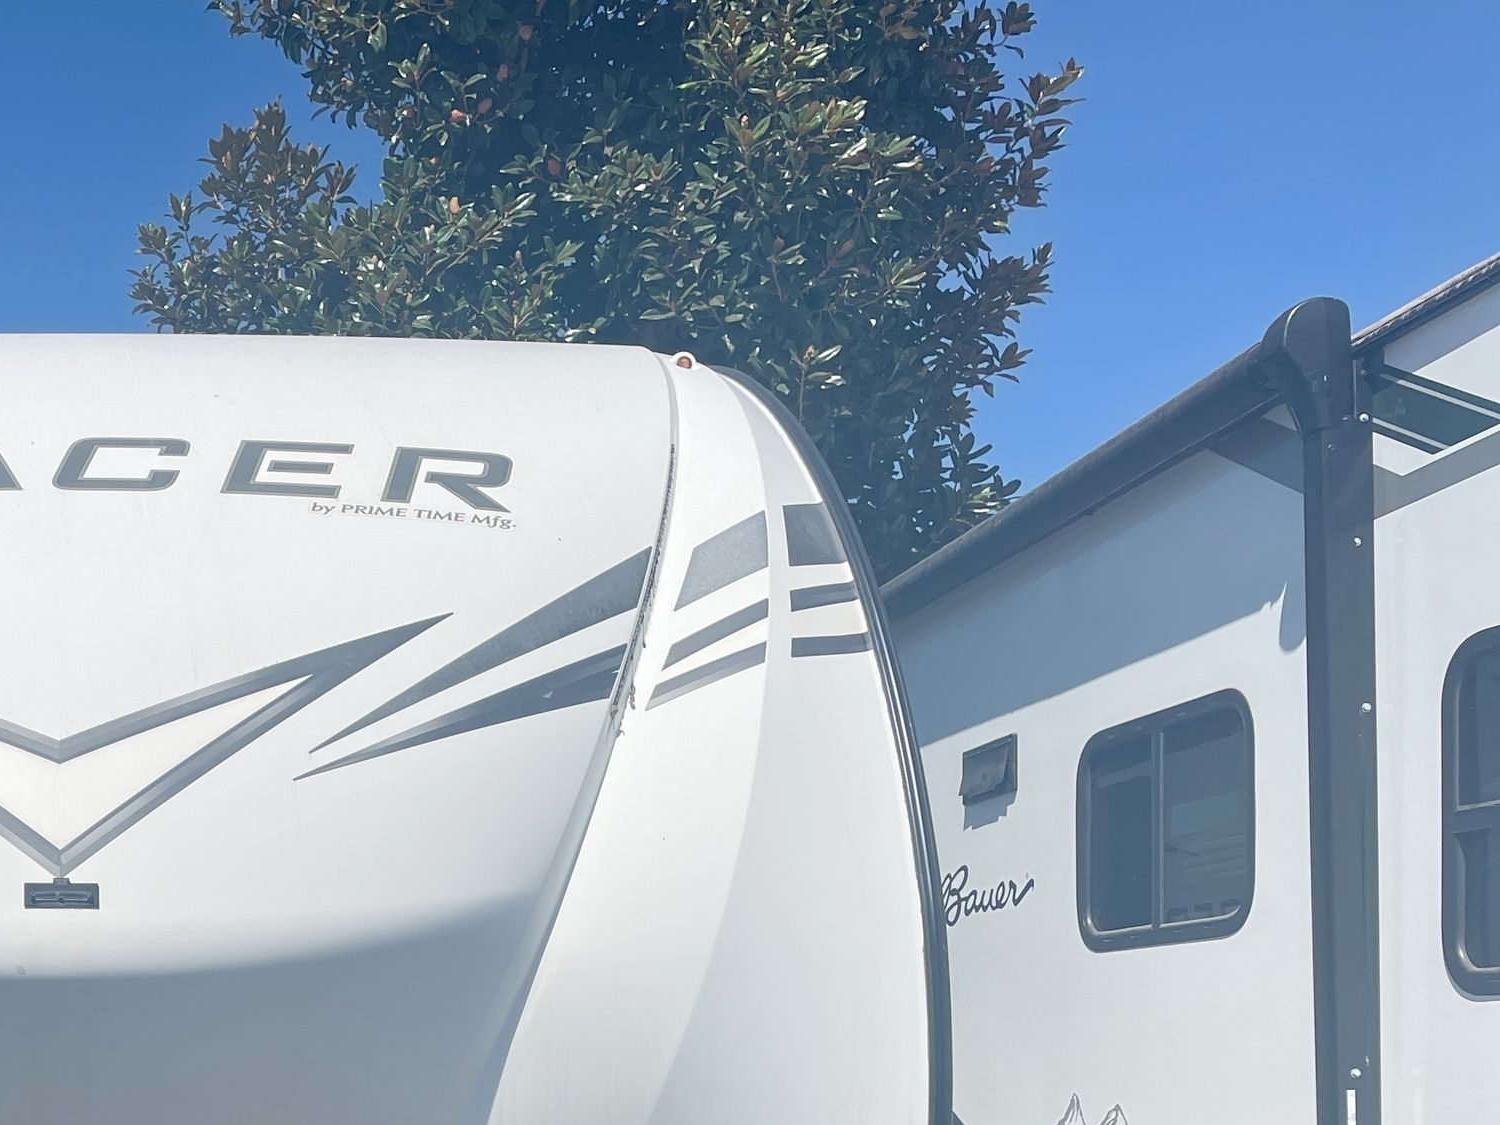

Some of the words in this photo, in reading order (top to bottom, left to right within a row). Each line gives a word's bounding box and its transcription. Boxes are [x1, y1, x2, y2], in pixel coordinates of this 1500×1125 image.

[311, 501, 336, 516] by
[341, 503, 407, 518] PRIME
[414, 508, 466, 523] TIME
[471, 513, 517, 530] Mfg.
[941, 864, 1035, 927] Bauer
